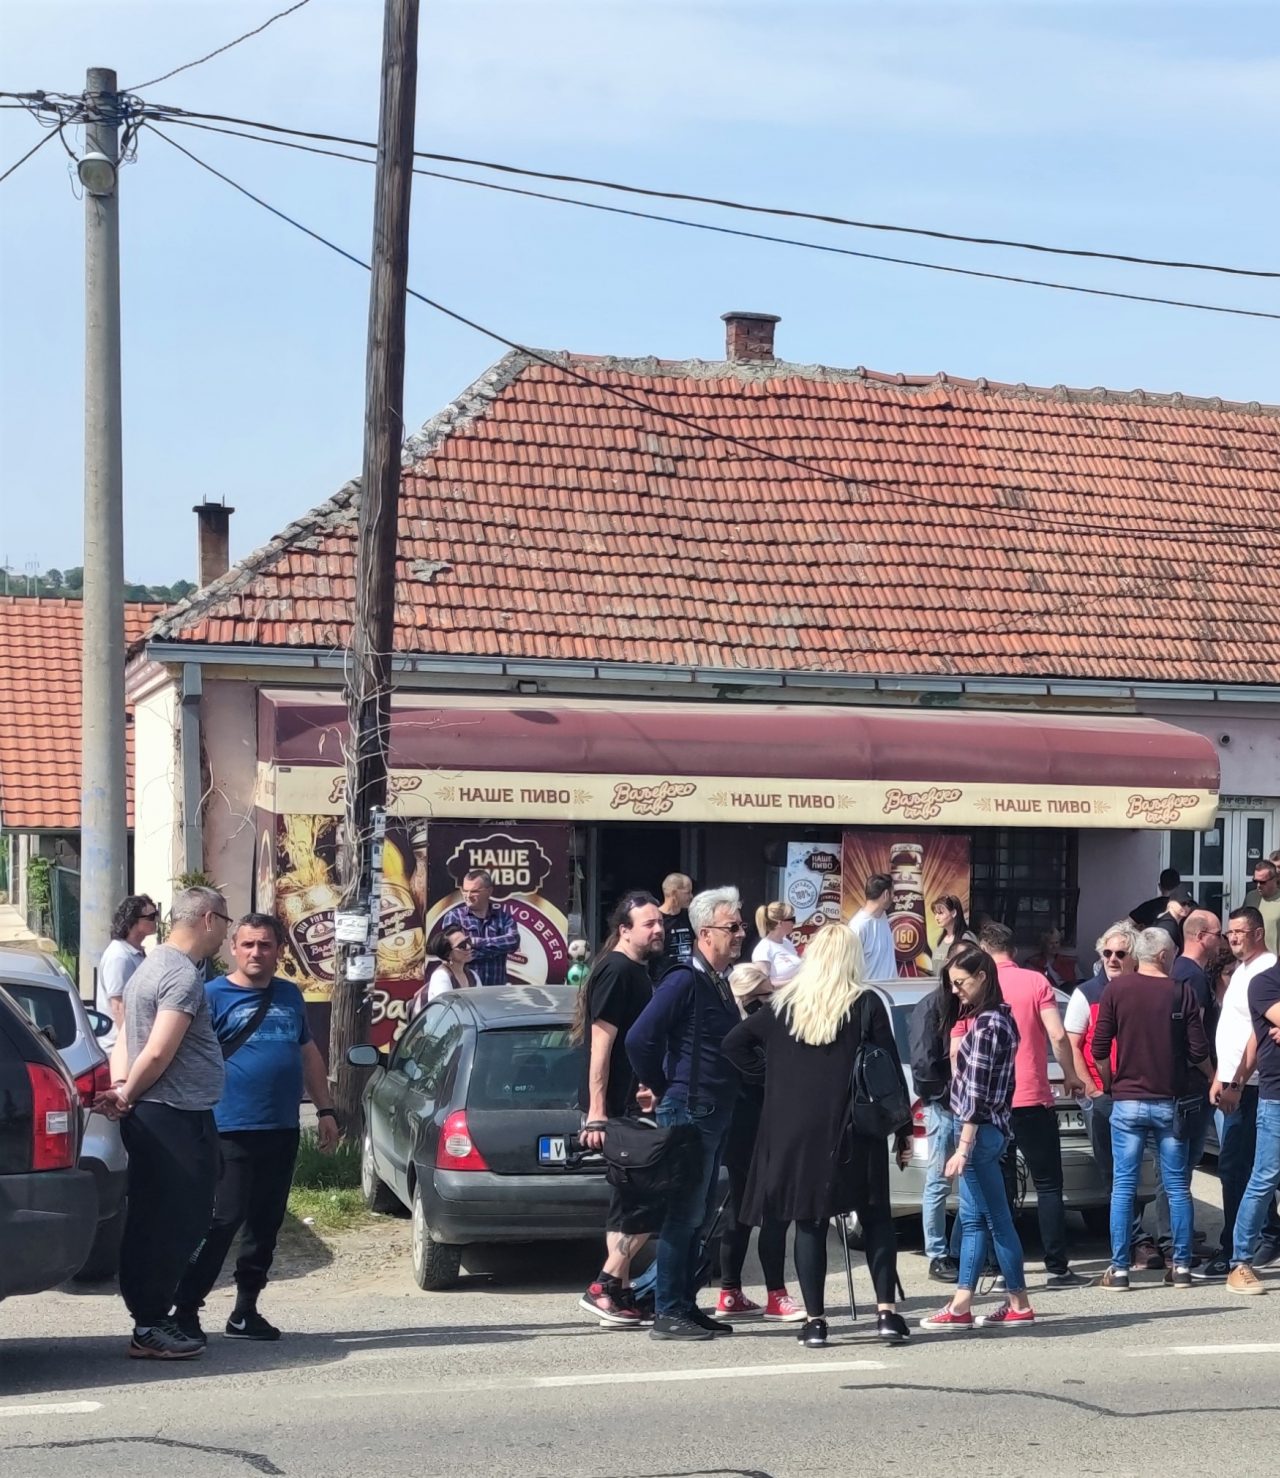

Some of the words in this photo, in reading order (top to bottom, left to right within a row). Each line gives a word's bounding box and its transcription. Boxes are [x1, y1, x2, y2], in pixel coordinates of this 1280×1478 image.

[459, 787, 514, 803] НАШЕ
[520, 789, 571, 804] ПИВО
[731, 793, 782, 808] НАШЕ
[788, 794, 835, 809] ПИВО
[995, 799, 1042, 813] НАШЕ
[1048, 800, 1091, 814] ПИВО
[468, 849, 530, 866] НАШЕ
